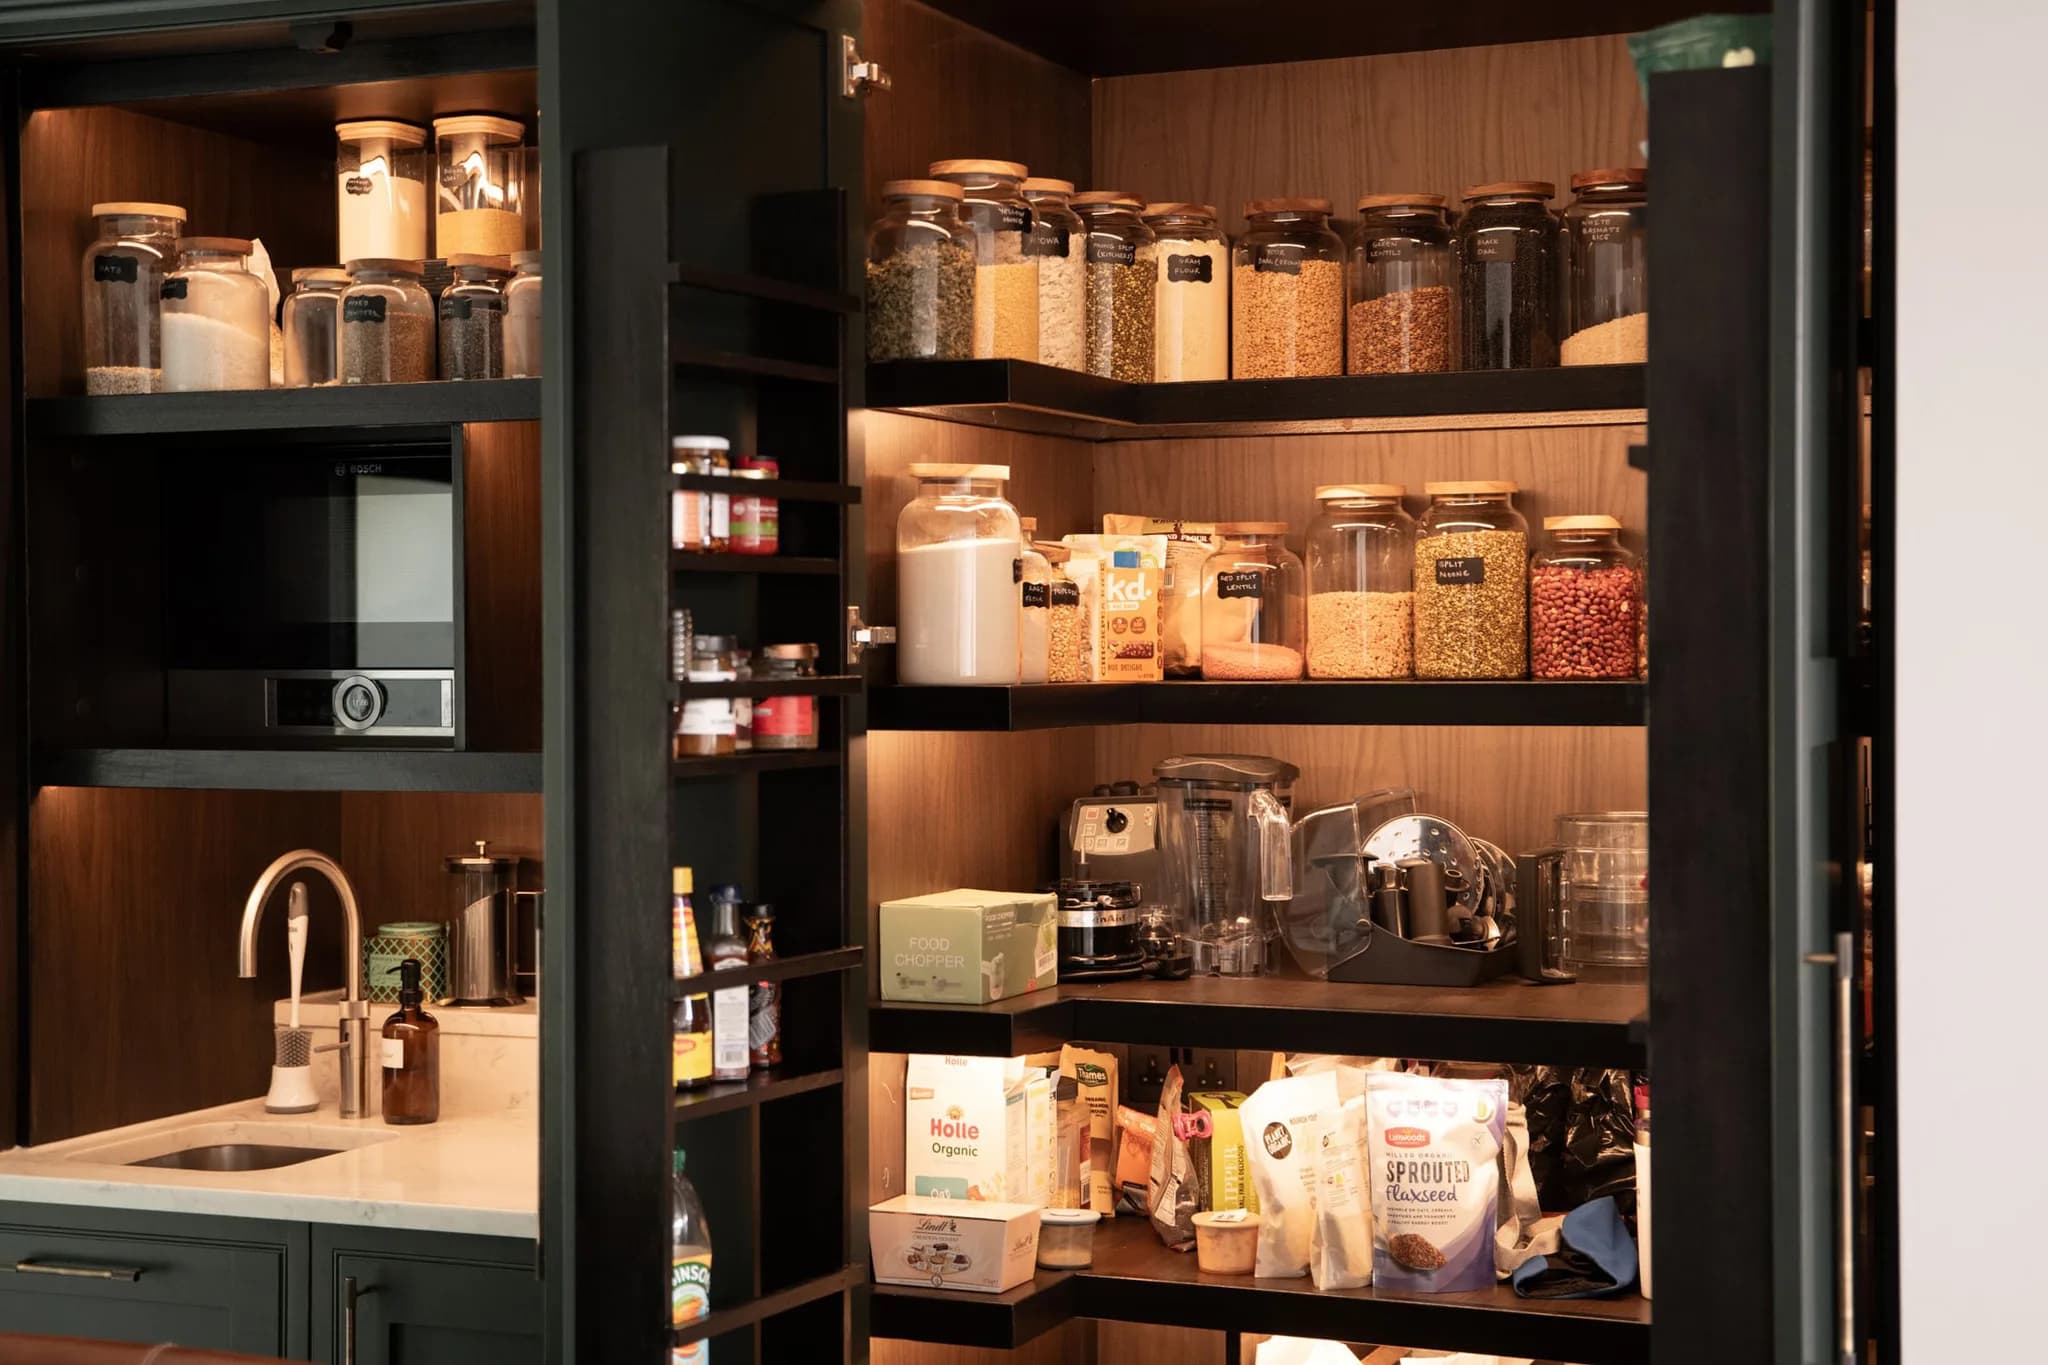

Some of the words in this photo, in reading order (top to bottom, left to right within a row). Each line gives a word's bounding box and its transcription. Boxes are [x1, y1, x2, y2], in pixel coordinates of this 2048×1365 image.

[909, 937, 950, 951] FOOD
[895, 953, 965, 968] CHOPPER
[930, 1117, 980, 1140] Holle
[931, 1142, 979, 1158] Organic
[1386, 1160, 1471, 1184] SPROUTED
[916, 1219, 949, 1232] Lindt
